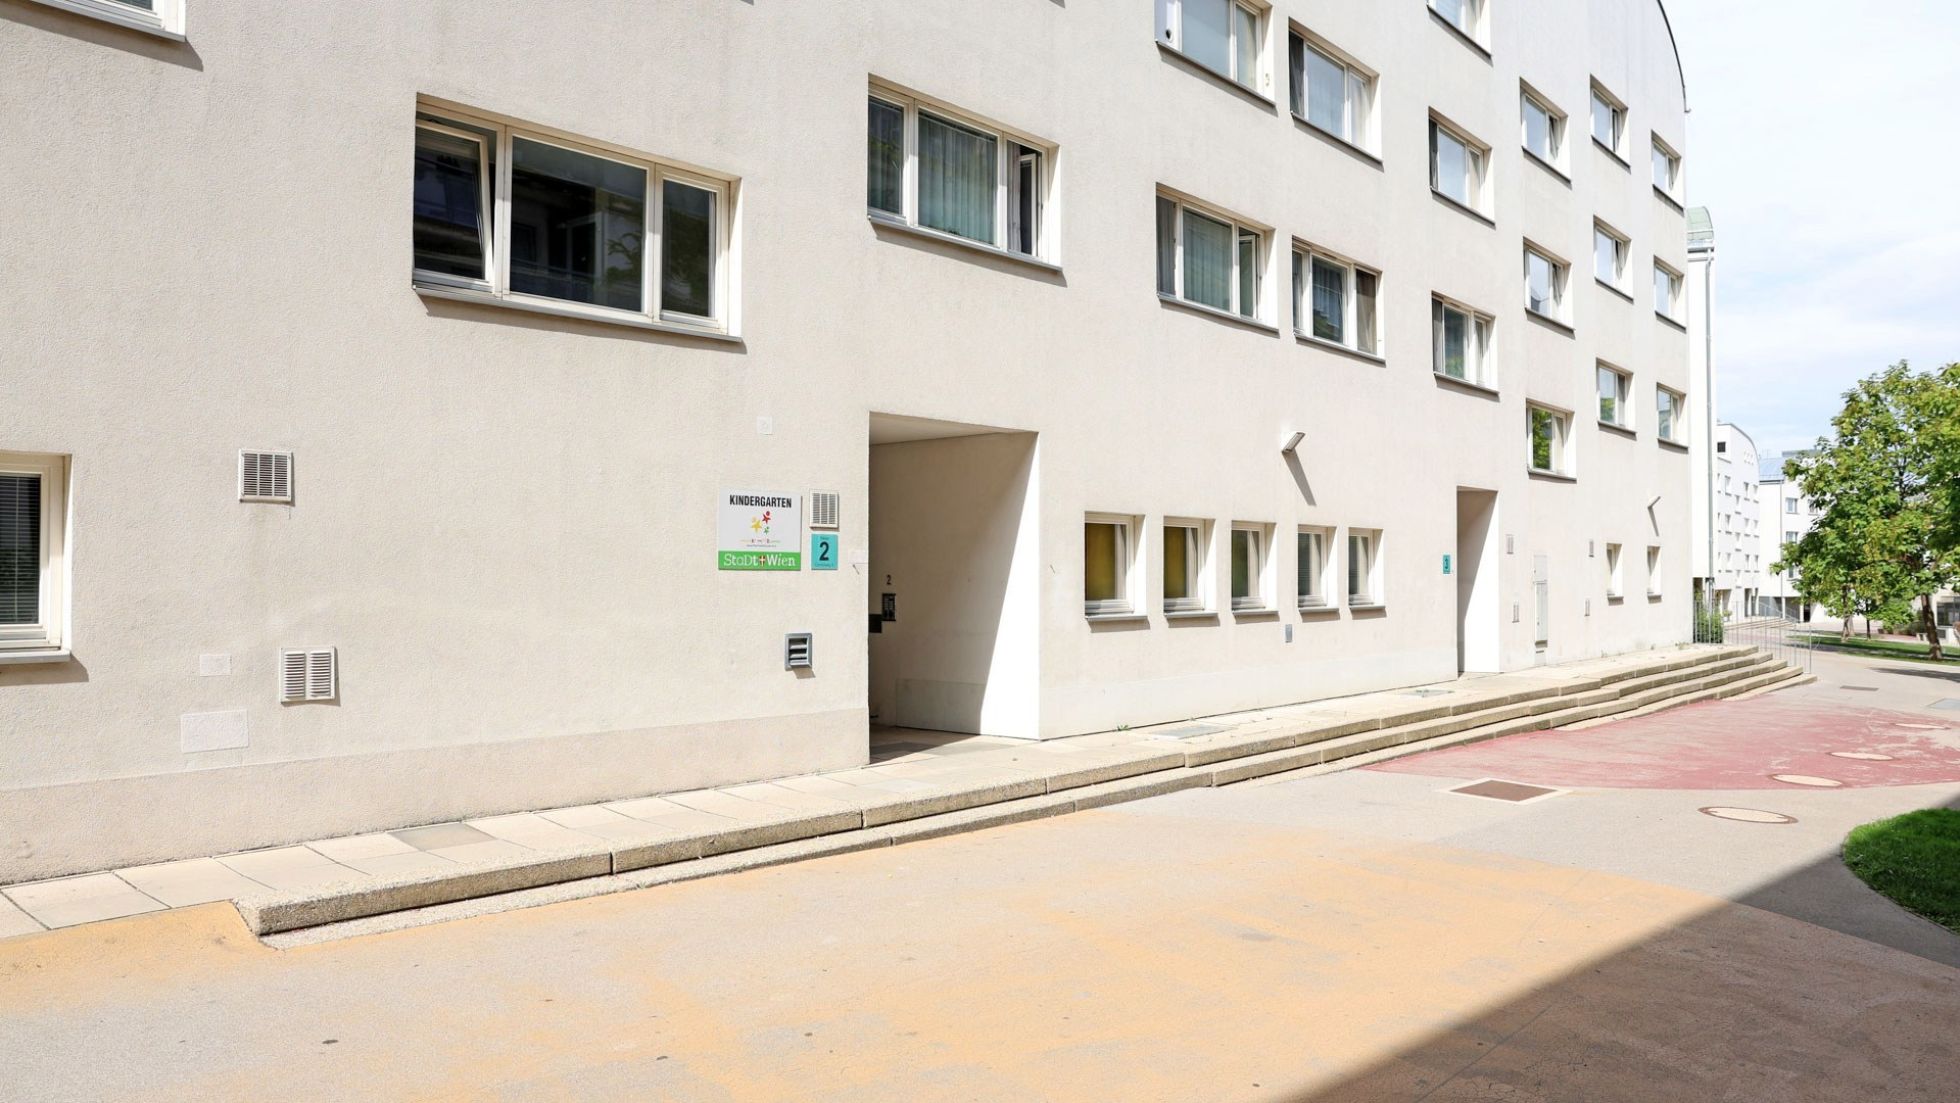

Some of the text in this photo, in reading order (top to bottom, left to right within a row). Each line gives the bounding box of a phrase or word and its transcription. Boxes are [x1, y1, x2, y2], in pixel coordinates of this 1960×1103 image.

[729, 495, 792, 508] KINDERGARTEN
[819, 541, 830, 561] 2
[766, 553, 796, 567] Wien
[886, 574, 892, 585] 2
